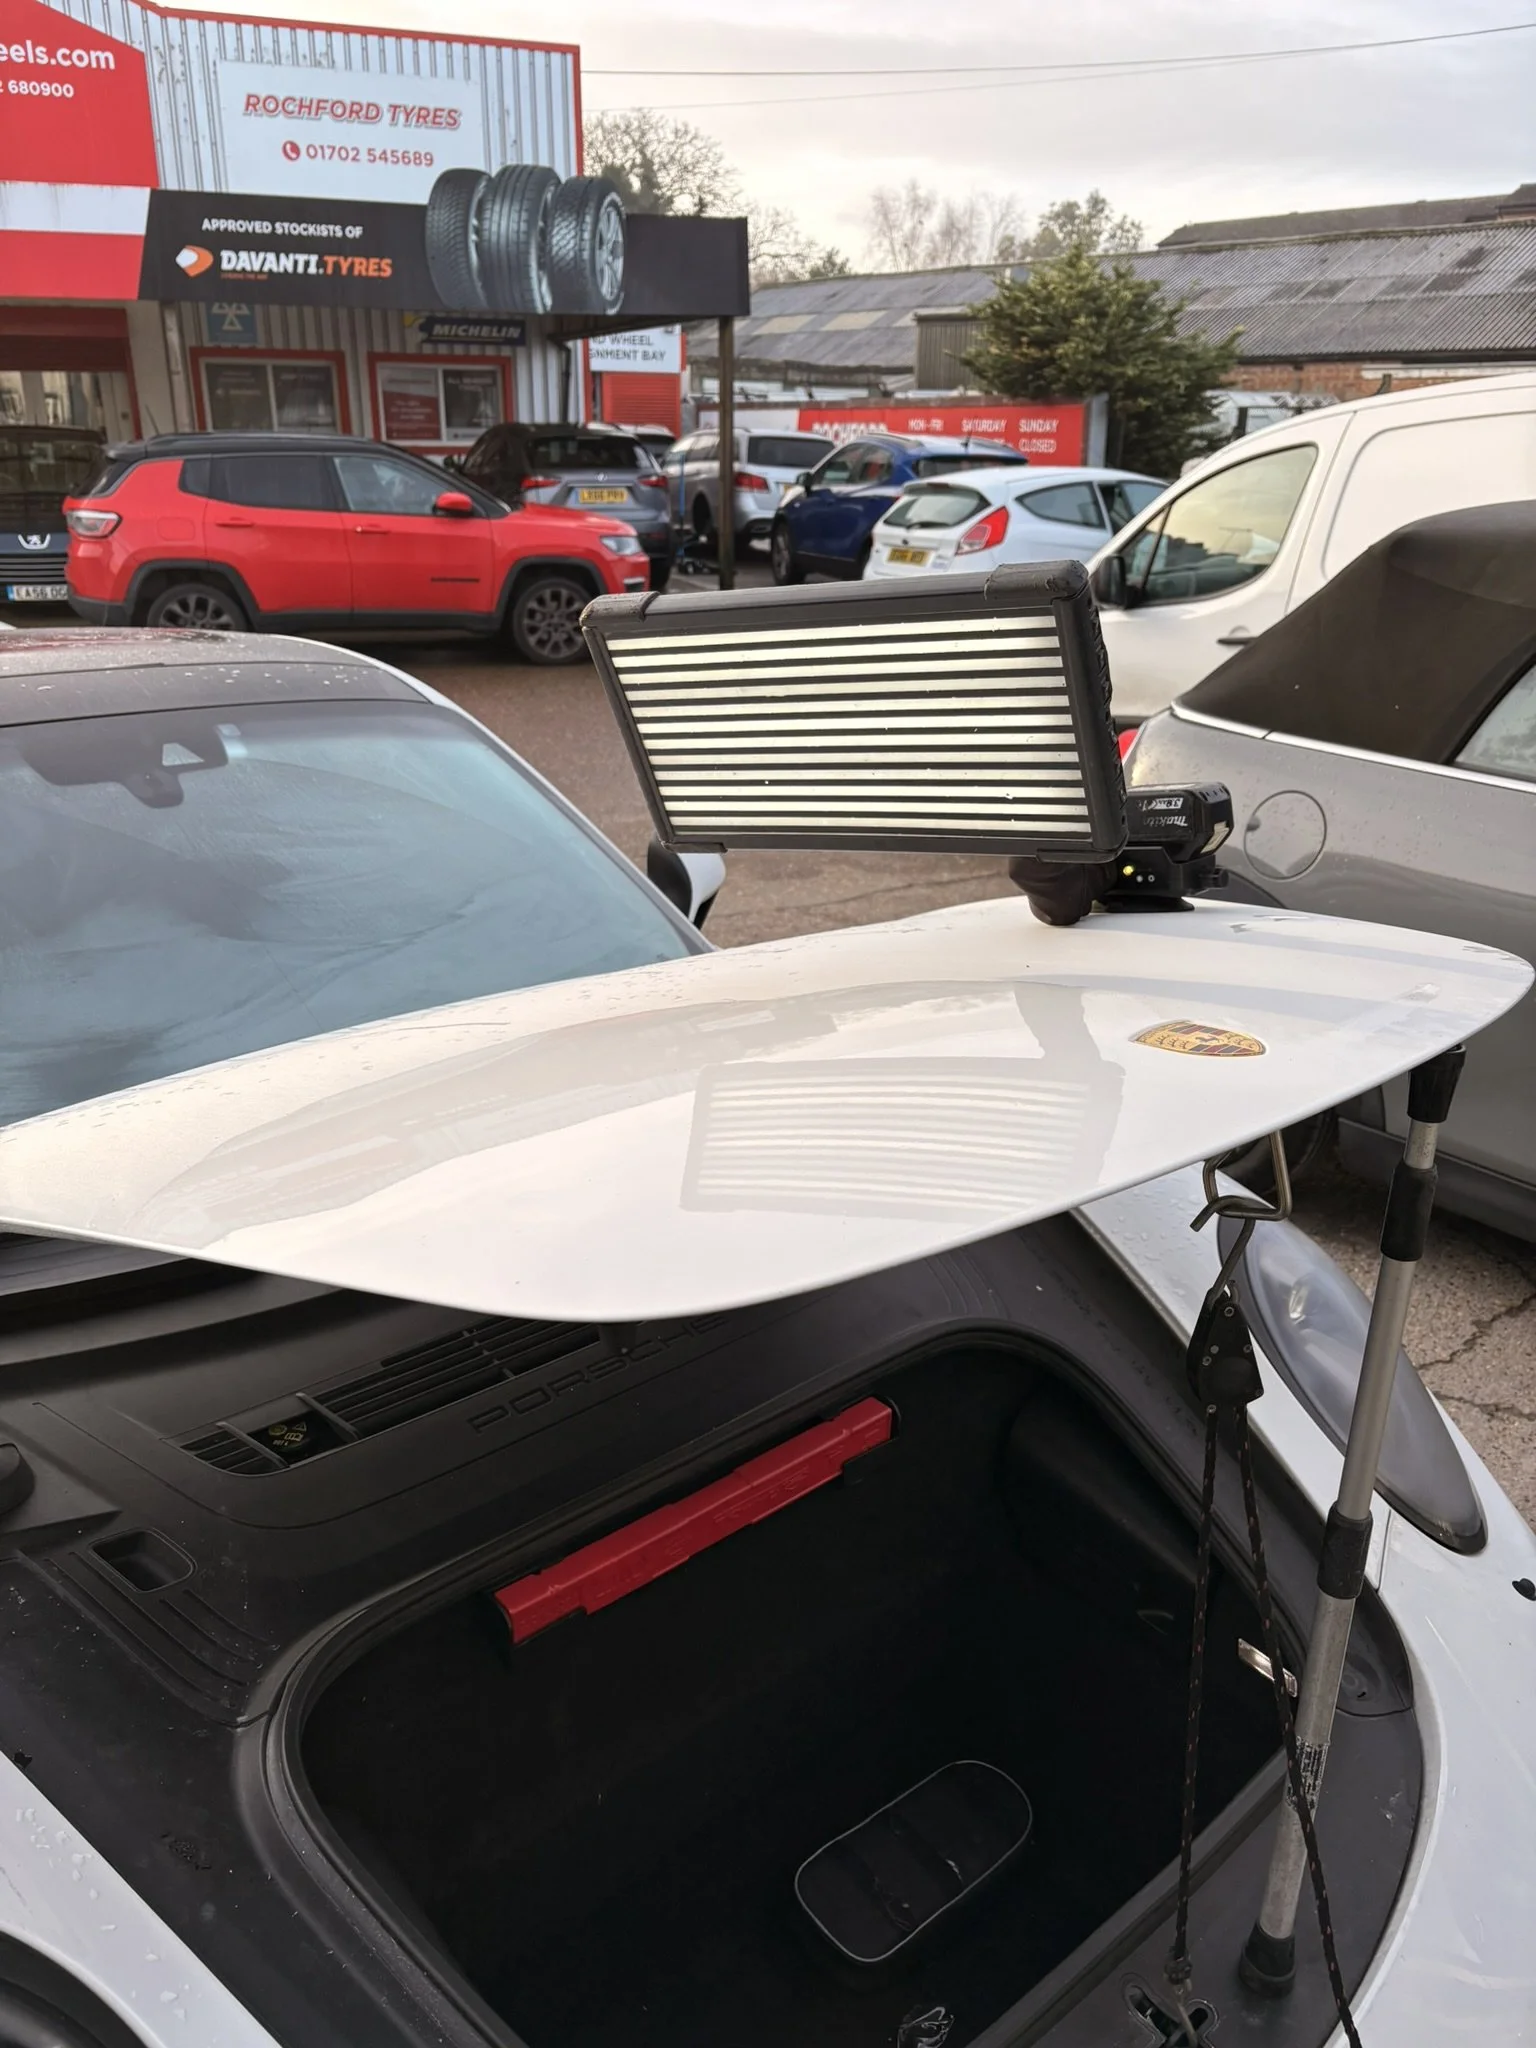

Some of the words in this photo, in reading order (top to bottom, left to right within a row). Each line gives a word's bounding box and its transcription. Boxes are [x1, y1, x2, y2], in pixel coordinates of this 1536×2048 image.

[8, 80, 74, 98] 680900
[244, 93, 382, 123] ROCHFORD
[387, 104, 462, 129] TYRES
[306, 144, 360, 162] 01702
[367, 148, 434, 167] 545689
[201, 218, 272, 234] APPROVED
[274, 221, 343, 238] STOCKISTS
[345, 225, 363, 239] OF
[432, 324, 522, 338] MICHELIN
[610, 333, 654, 346] WHEEL
[641, 349, 666, 361] BAY
[961, 419, 1007, 432] SATURDAY
[1019, 419, 1060, 432] SUNDAY
[1019, 438, 1057, 453] CLOSED
[1143, 815, 1188, 827] makita
[467, 1314, 728, 1434] PORSCHE
